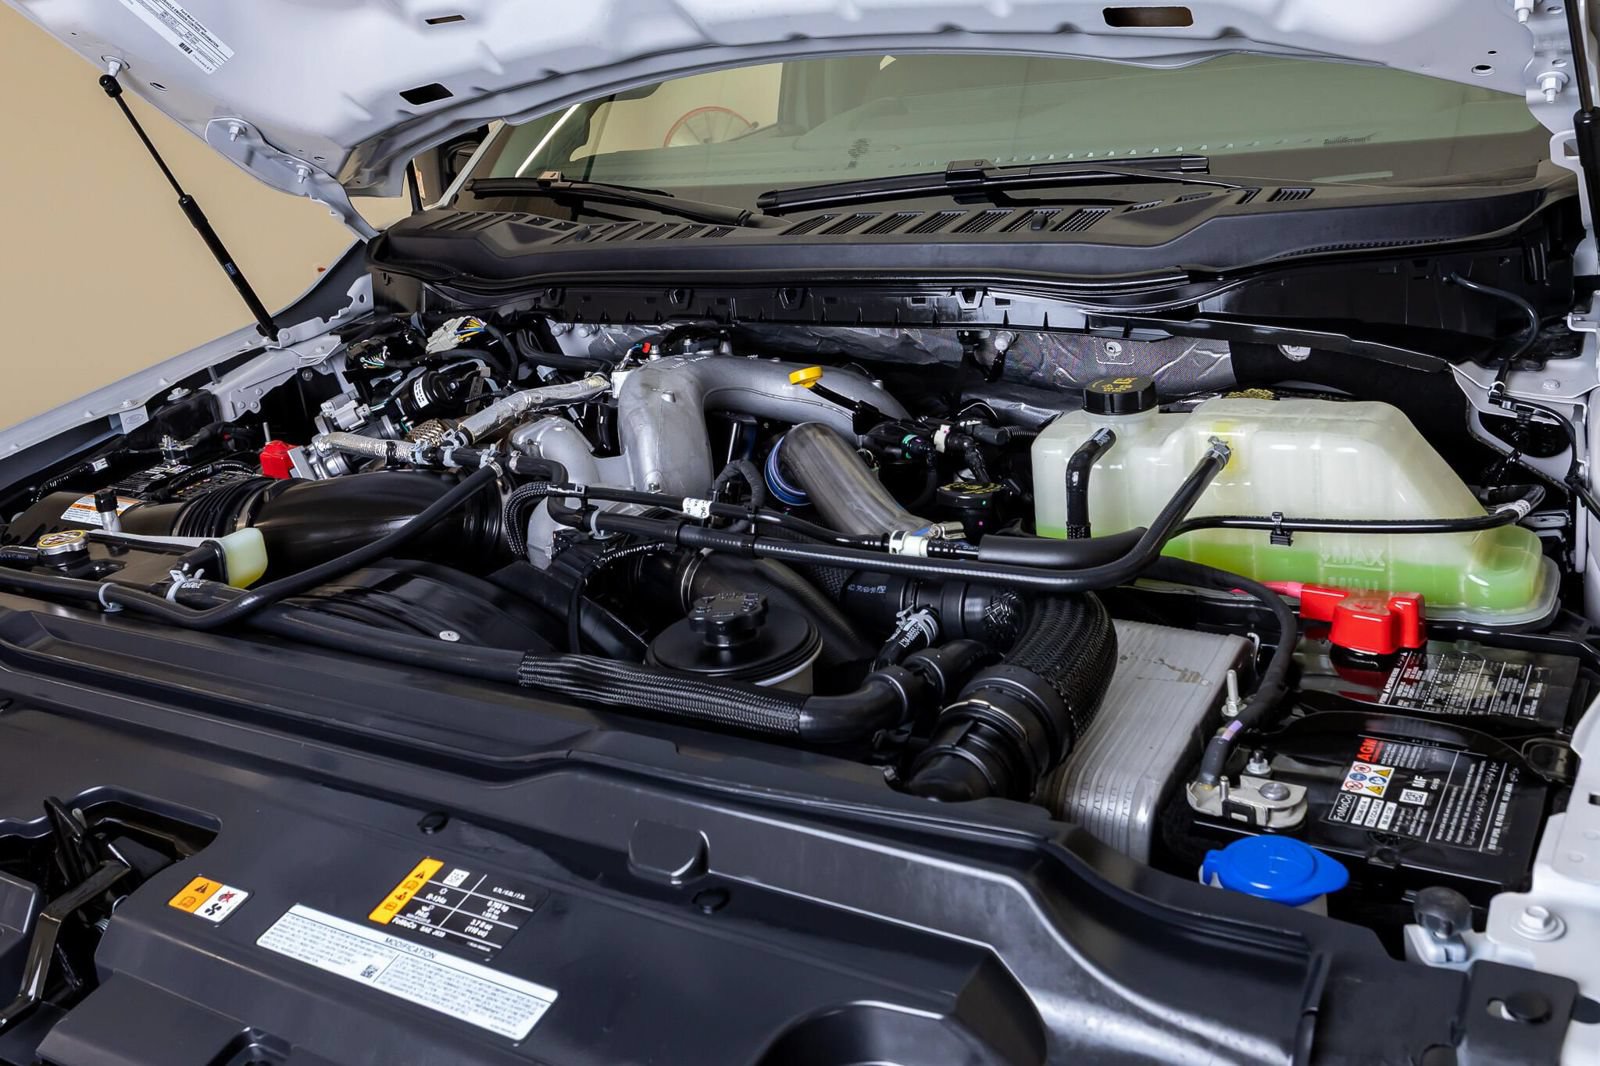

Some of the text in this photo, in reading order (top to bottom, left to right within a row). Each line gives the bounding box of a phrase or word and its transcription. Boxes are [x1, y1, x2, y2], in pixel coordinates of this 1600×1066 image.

[1356, 738, 1377, 761] AGM
[1412, 776, 1427, 788] MF
[1334, 795, 1352, 821] FoMoCo
[392, 917, 417, 929] FoMoCo
[386, 937, 436, 960] MODIFICATION
